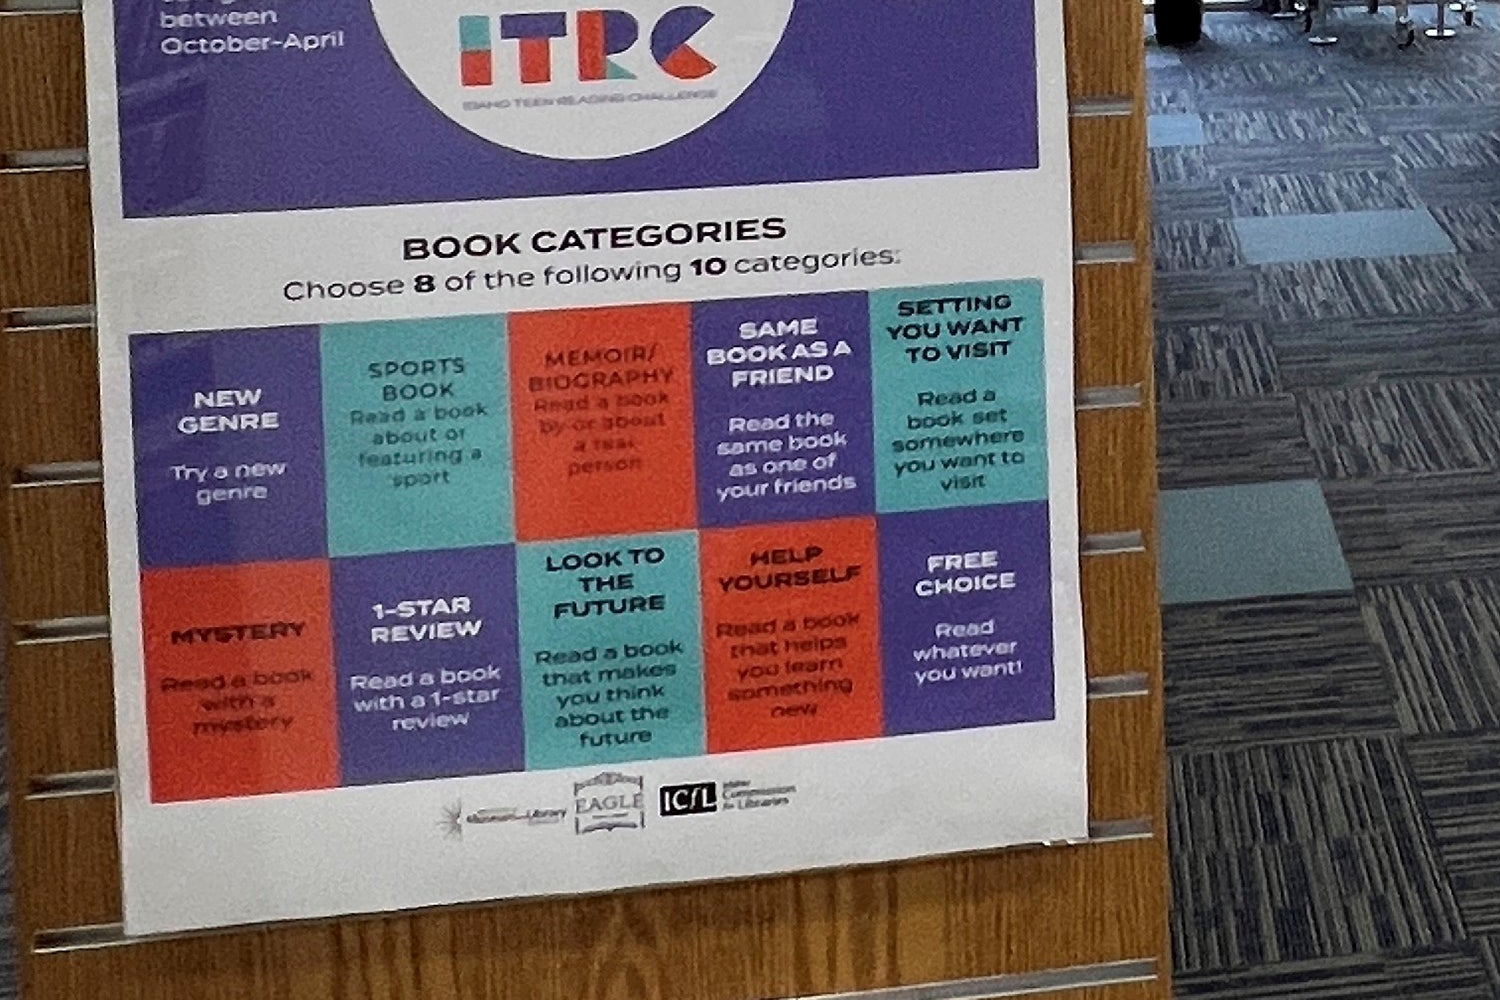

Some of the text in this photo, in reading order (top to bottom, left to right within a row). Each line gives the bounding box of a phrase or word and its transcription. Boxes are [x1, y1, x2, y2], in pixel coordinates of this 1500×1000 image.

[160, 9, 277, 28] between
[161, 31, 344, 55] October-April
[459, 5, 717, 86] ITRC
[403, 218, 786, 260] BOOK CATEGORIES
[283, 247, 901, 301] Choose 8 of the following 10 categories:
[898, 295, 1011, 316] SETTING
[739, 319, 818, 339] SAME
[887, 317, 1024, 340] YOU WANT
[545, 342, 656, 367] MEMOIR/
[707, 339, 851, 365] BOOK AS A
[906, 341, 1011, 361] TO VISIT
[368, 357, 465, 378] SPORTS
[732, 365, 833, 388] FRIEND
[383, 382, 454, 400] BOOK
[529, 367, 673, 392] BIOGRAPHY
[194, 388, 262, 408] NEW
[918, 390, 995, 406] Read a
[178, 411, 279, 435] GENRE
[350, 403, 488, 426] Read a book
[728, 410, 834, 435] Read the
[907, 409, 1006, 429] book set
[372, 429, 436, 446] about
[717, 431, 847, 456] same book
[892, 429, 1024, 451] somewhere
[359, 448, 482, 468] featuring a
[729, 452, 838, 477] as one of
[895, 451, 1024, 476] you want to
[171, 461, 285, 482] Try a new
[393, 470, 449, 487] sport
[941, 473, 985, 491] visit
[197, 486, 267, 505] genre
[717, 473, 857, 502] your friends
[546, 547, 664, 572] LOOK TO
[750, 546, 824, 565] HELP
[927, 551, 998, 571] FREE
[579, 575, 634, 593] THE
[718, 565, 861, 593] YOURSELF
[915, 573, 1015, 596] CHOICE
[371, 597, 470, 620] 1-STAR
[554, 594, 664, 620] FUTURE
[171, 622, 304, 644] MYSTERY
[371, 620, 482, 643] REVIEW
[935, 620, 994, 638] Read
[535, 638, 682, 666] Read a book
[913, 641, 1017, 660] whatever
[350, 665, 501, 690] Read a book
[543, 663, 676, 687] that makes
[914, 661, 1022, 686] you want!
[354, 687, 500, 711] with a 1-star
[556, 682, 664, 709] you think
[392, 711, 469, 730] review
[554, 705, 669, 729] about the
[580, 727, 652, 747] future
[576, 793, 644, 813] EAGLE
